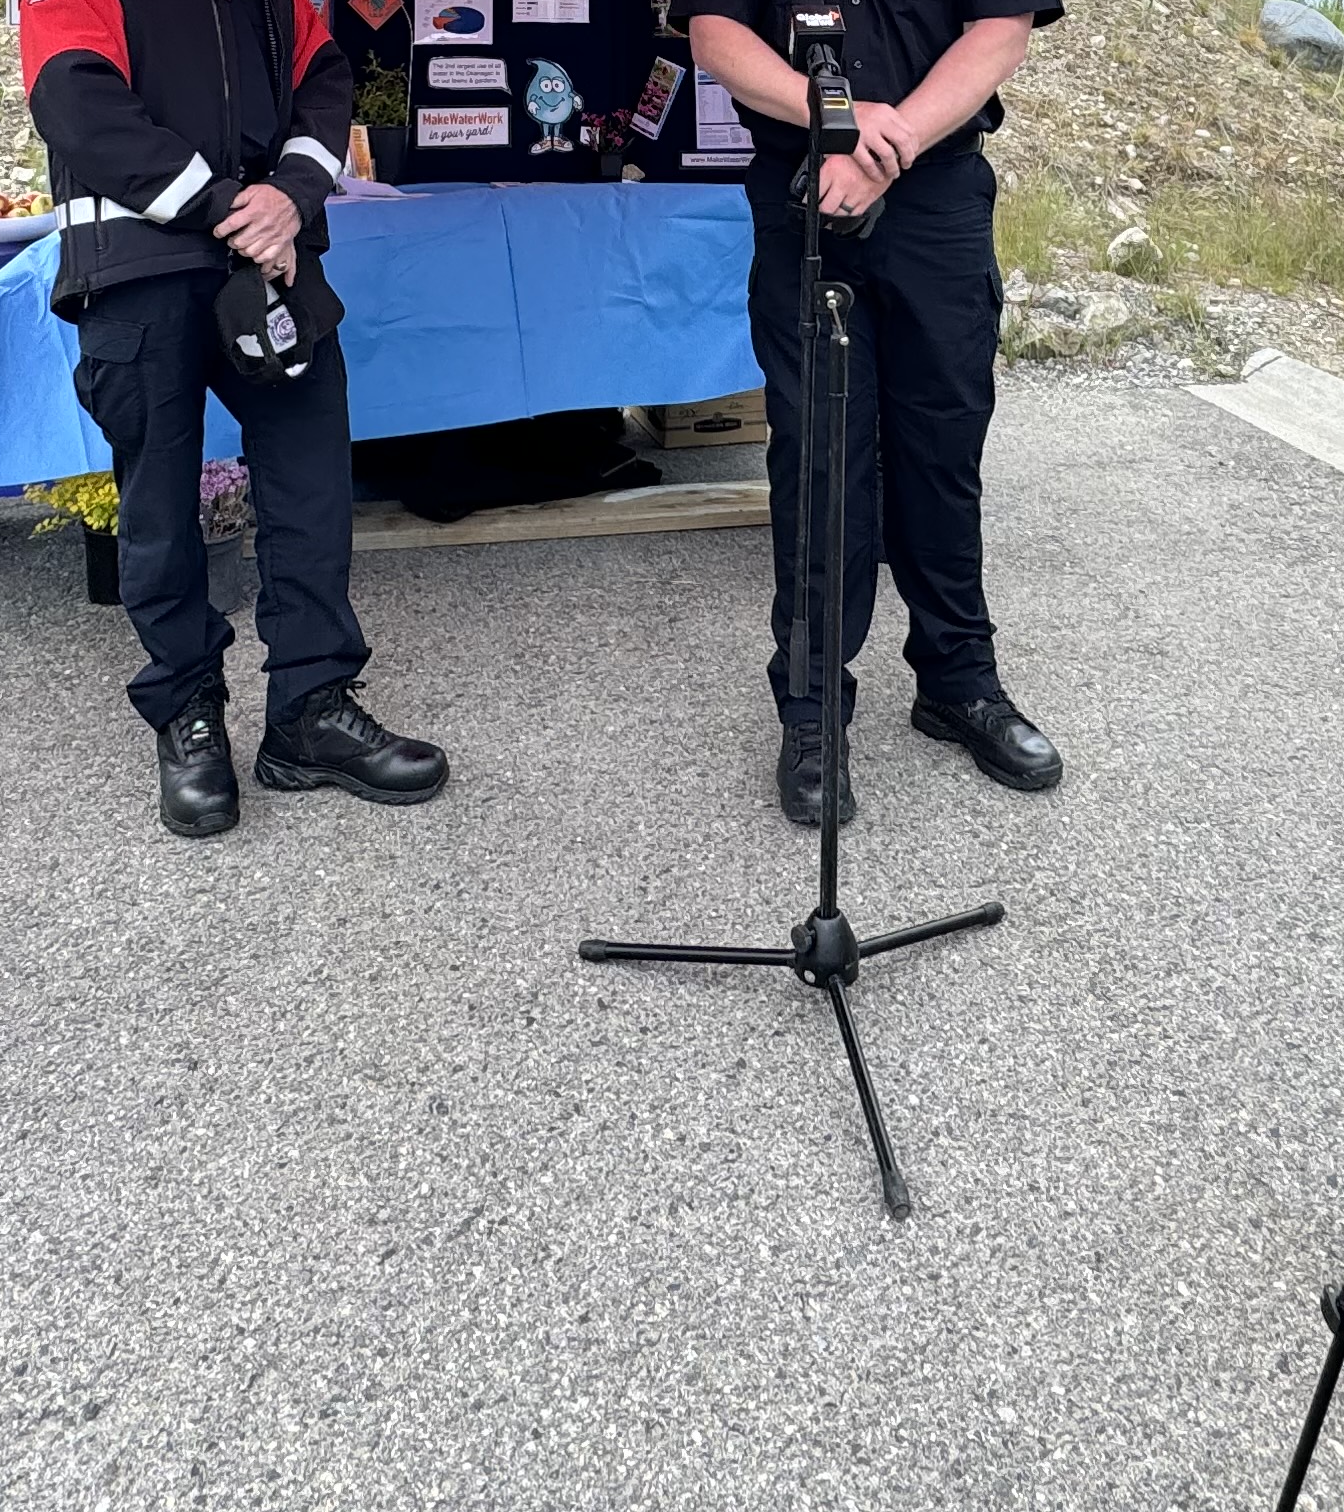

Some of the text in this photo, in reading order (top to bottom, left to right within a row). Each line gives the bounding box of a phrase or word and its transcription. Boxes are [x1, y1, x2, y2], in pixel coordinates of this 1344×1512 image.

[795, 12, 833, 22] Global
[422, 111, 504, 126] MakeWaterWork
[428, 125, 494, 143] in your yard!
